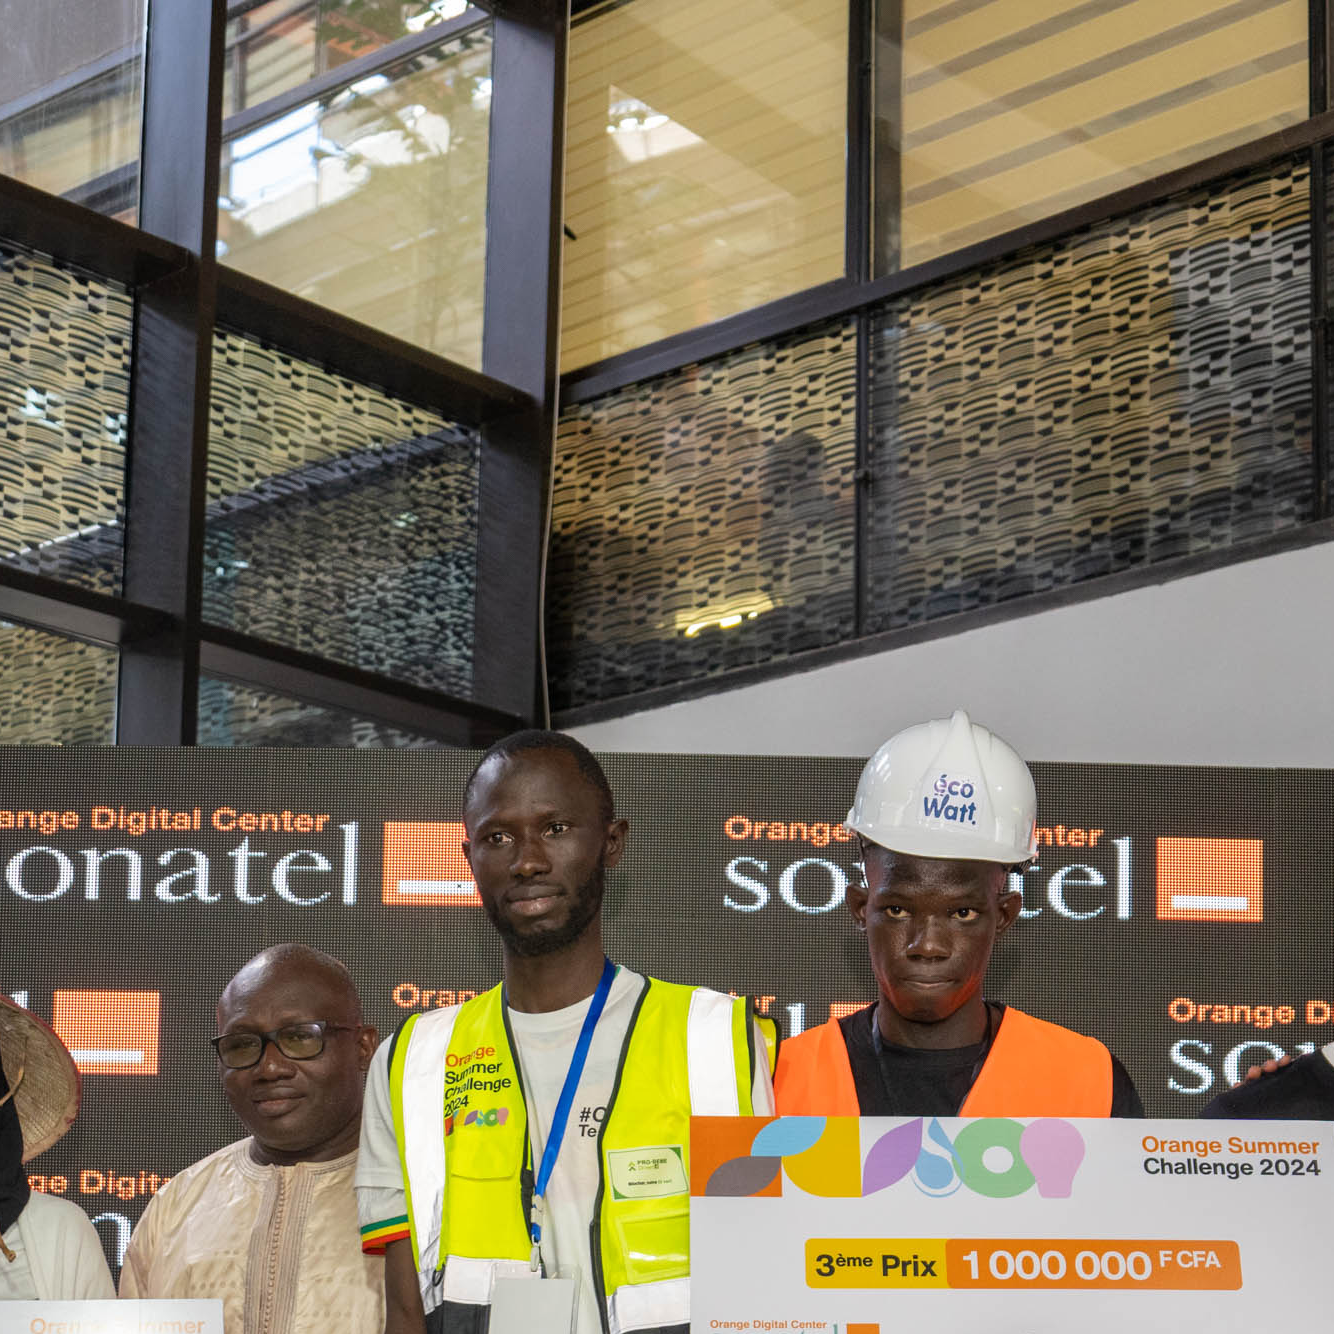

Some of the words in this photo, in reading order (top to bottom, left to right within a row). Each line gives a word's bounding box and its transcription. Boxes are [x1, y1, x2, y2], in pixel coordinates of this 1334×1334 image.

[91, 805, 202, 836] Digital
[211, 806, 331, 833] Center
[1034, 824, 1105, 848] nter
[392, 983, 489, 1009] Oran
[1168, 997, 1296, 1029] Orange
[445, 1046, 496, 1068] Orange
[445, 1061, 503, 1085] Summer
[444, 1077, 512, 1100] Challenge
[444, 1094, 470, 1119] 2024
[1142, 1135, 1222, 1158] Orange
[1228, 1136, 1320, 1155] Summer
[1143, 1157, 1254, 1180] Challenge
[1259, 1158, 1322, 1176] 2024
[79, 1169, 171, 1201] Digit
[816, 1252, 873, 1277] 3ème
[882, 1254, 938, 1278] Prix
[1159, 1250, 1174, 1268] F
[1176, 1251, 1221, 1269] CFA
[710, 1319, 750, 1331] Orange
[753, 1319, 788, 1331] Digital
[791, 1320, 827, 1329] Center
